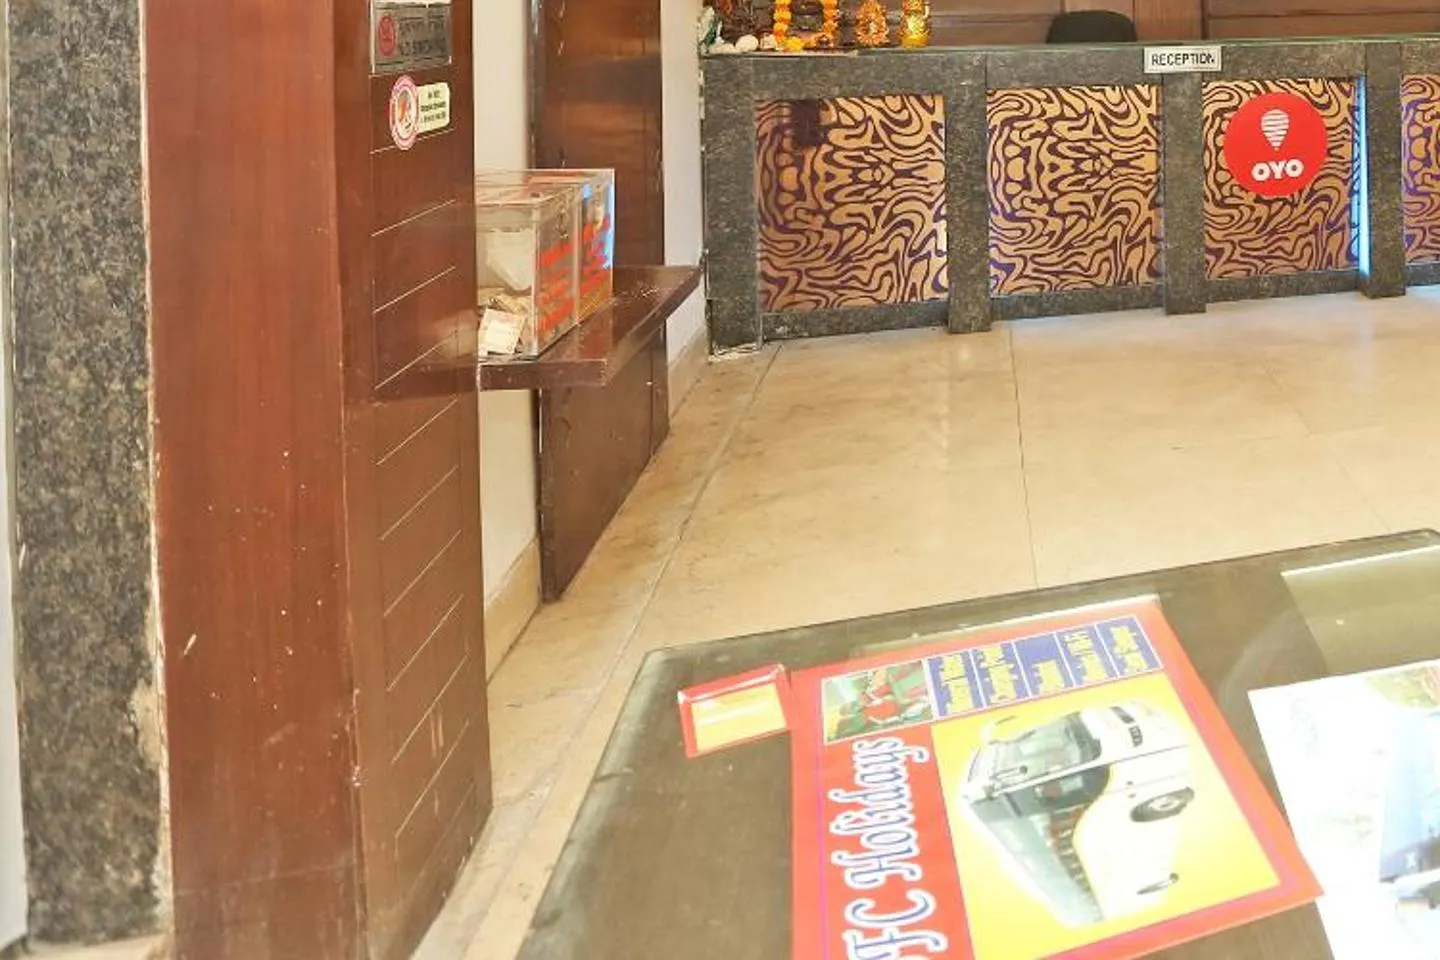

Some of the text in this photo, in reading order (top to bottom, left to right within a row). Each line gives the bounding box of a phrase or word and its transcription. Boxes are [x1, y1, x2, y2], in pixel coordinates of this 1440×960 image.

[1151, 52, 1215, 67] RECEPTION
[1251, 158, 1305, 182] OYO
[829, 738, 929, 890] Holidays
